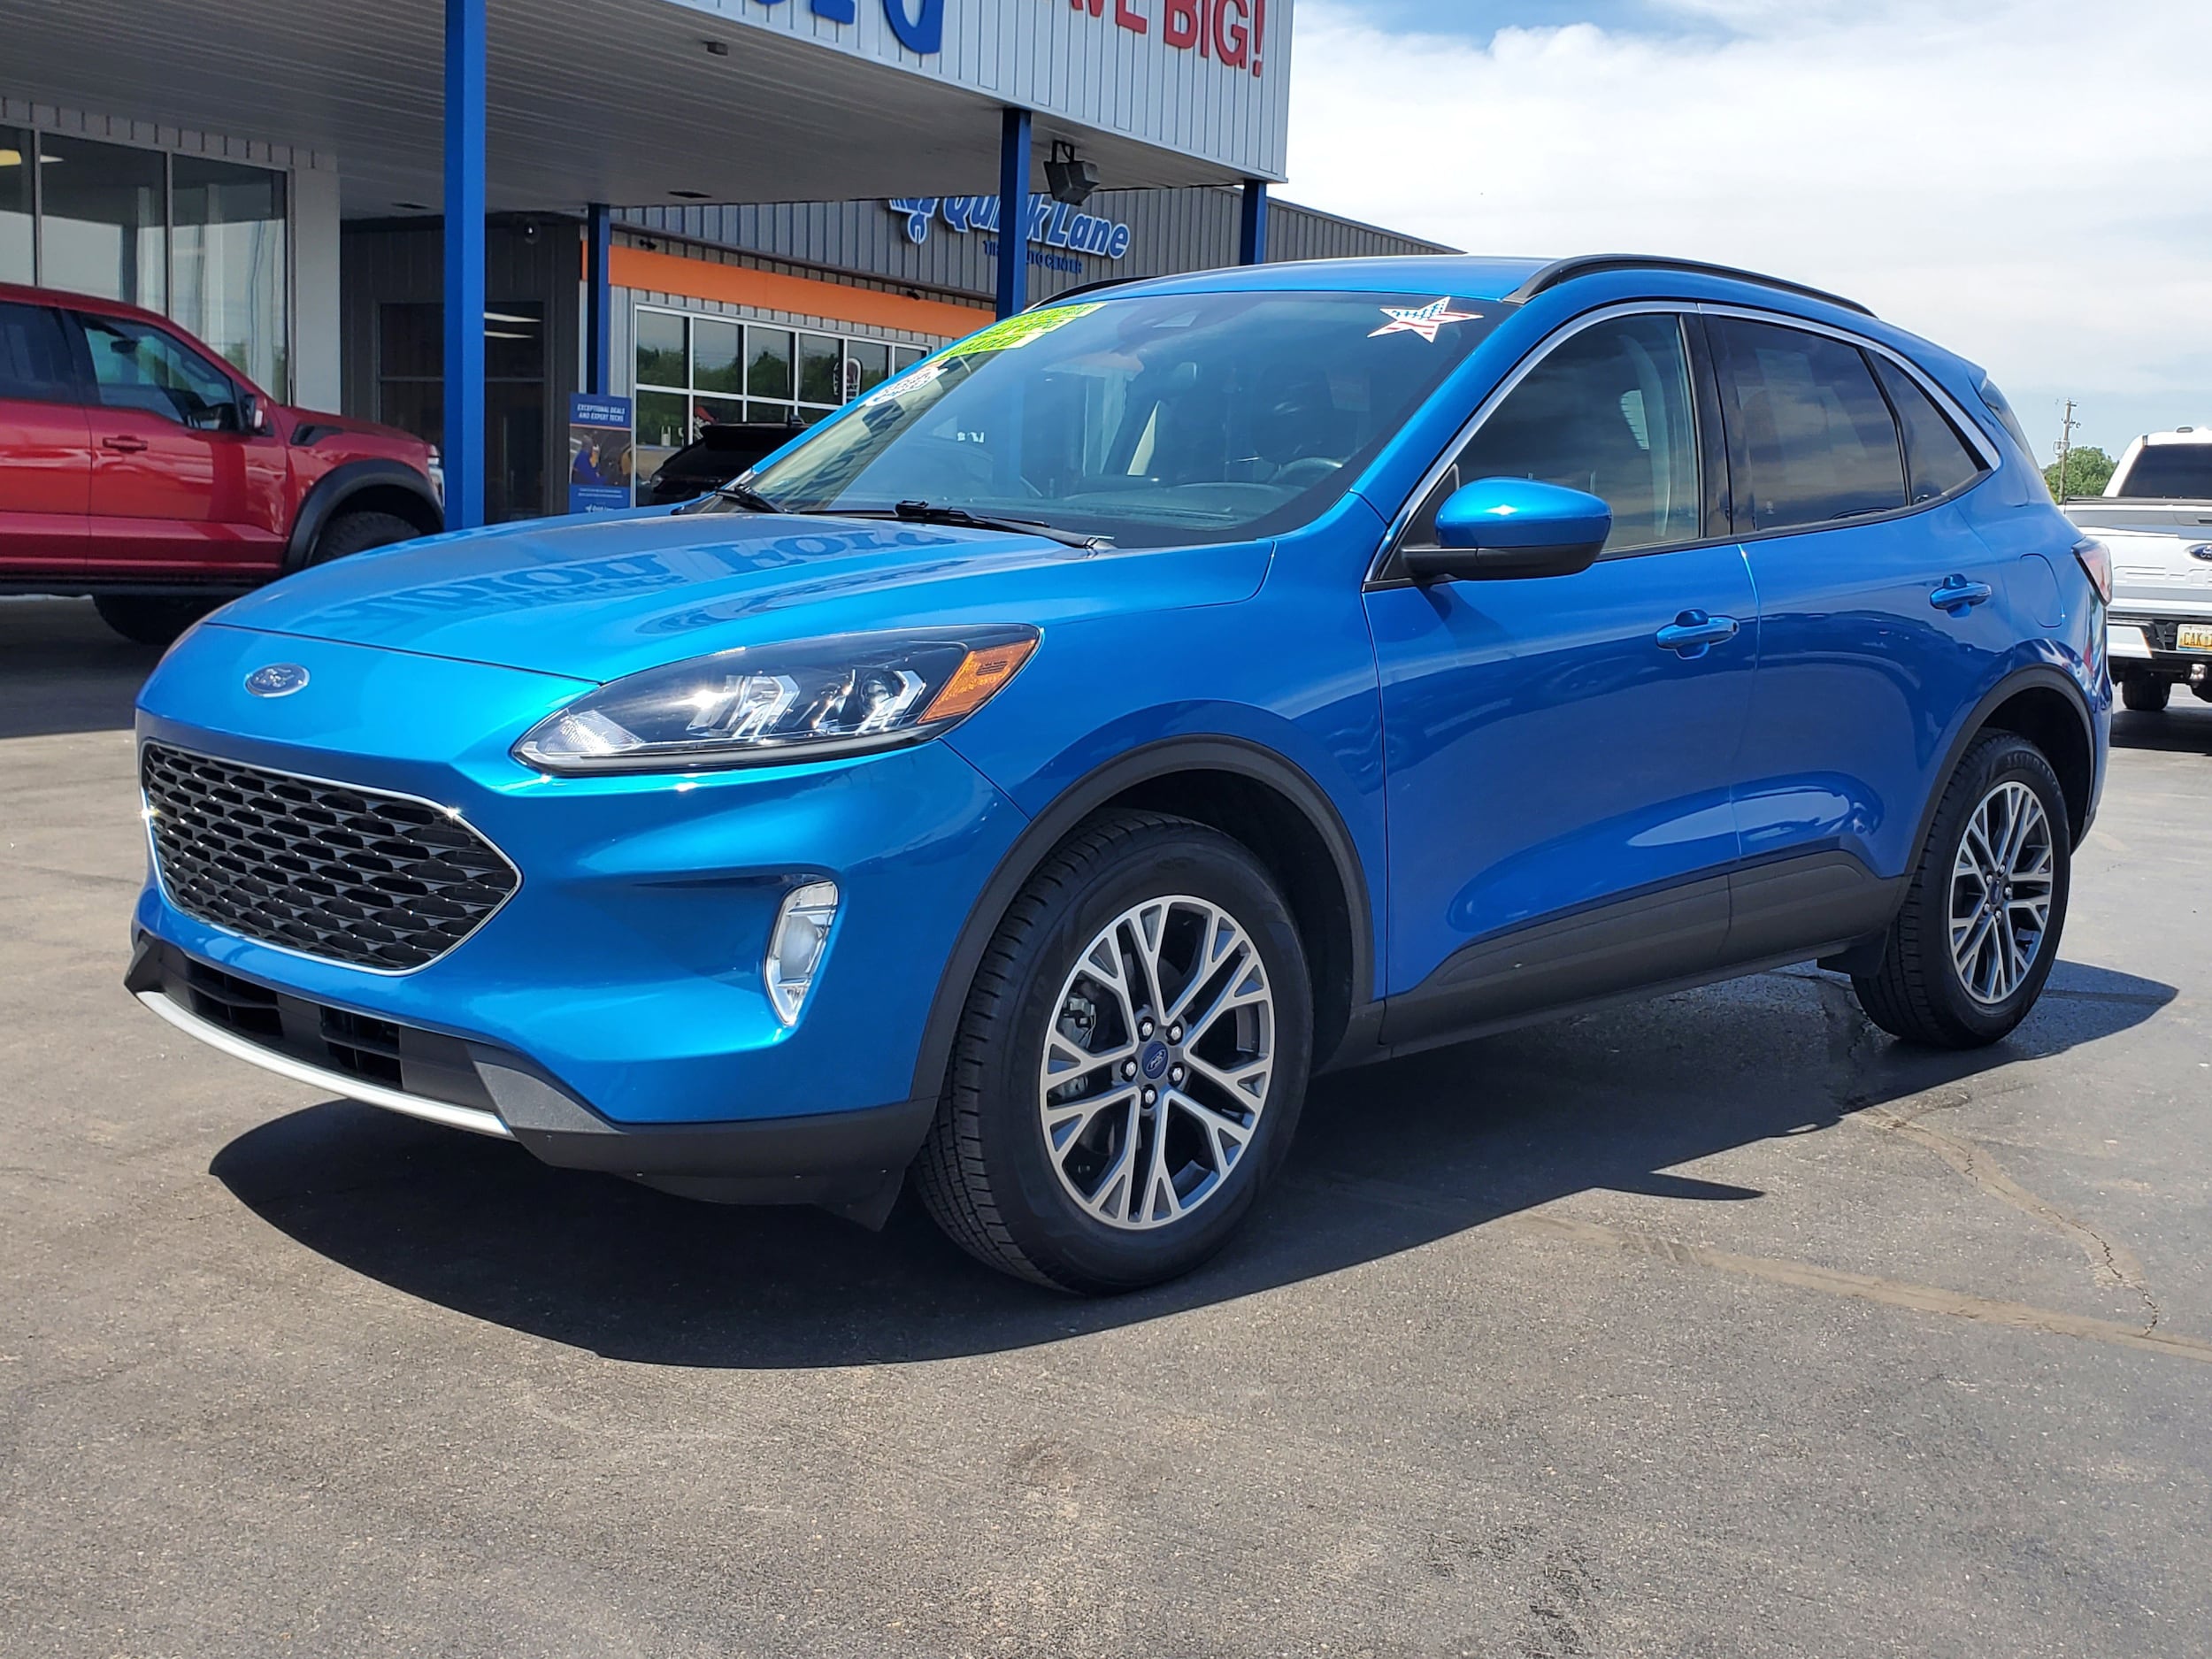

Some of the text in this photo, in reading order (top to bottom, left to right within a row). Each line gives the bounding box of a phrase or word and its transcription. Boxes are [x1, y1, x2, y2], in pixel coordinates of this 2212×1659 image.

[1164, 0, 1265, 77] BIG!
[943, 194, 1130, 258] Quk Lane
[1045, 253, 1082, 274] CENTER
[577, 403, 626, 415] EXCEPTIONAL DEALS
[591, 412, 609, 421] EXPERT
